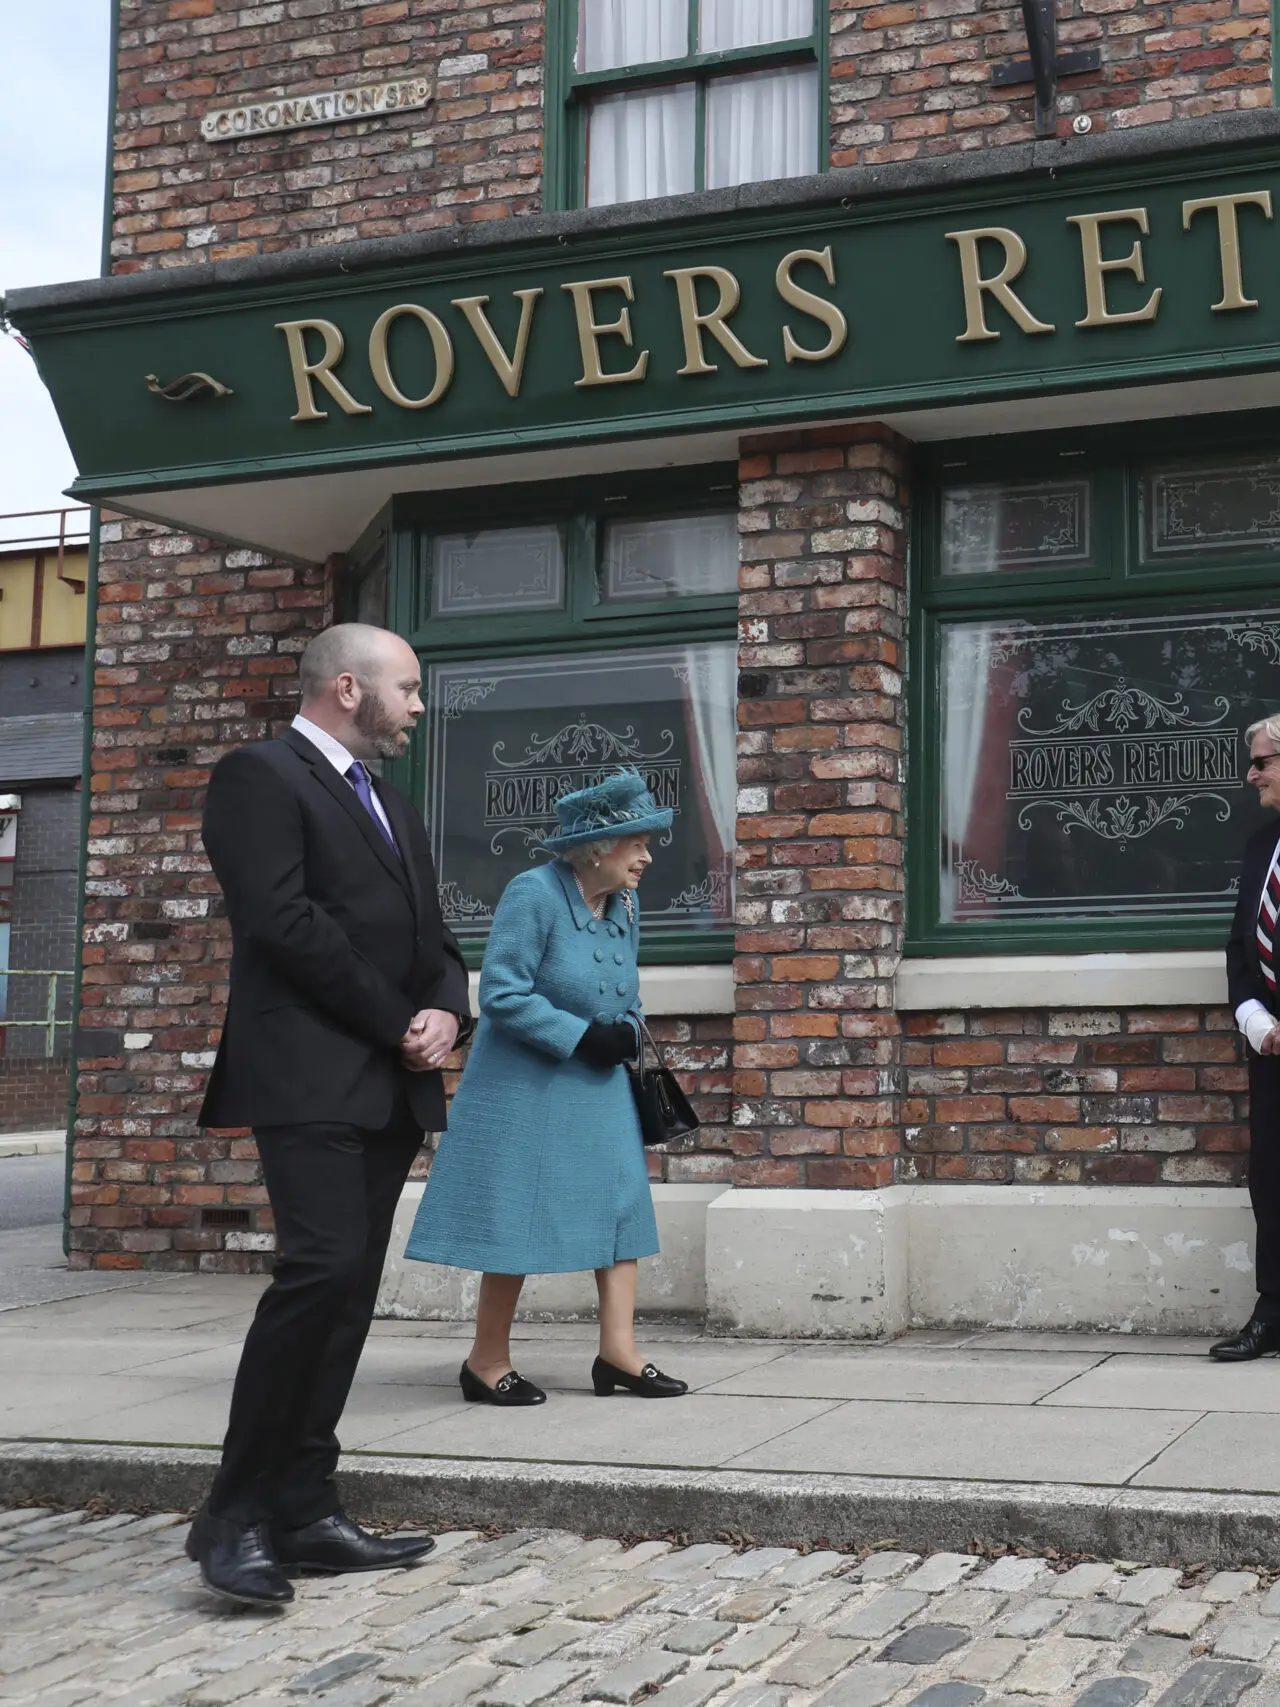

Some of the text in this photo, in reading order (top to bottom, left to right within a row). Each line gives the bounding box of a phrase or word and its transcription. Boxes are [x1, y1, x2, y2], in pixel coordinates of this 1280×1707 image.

[215, 88, 377, 135] CORONATION
[274, 245, 848, 422] ROVERS
[1010, 736, 1239, 789] ROVERS RETURN
